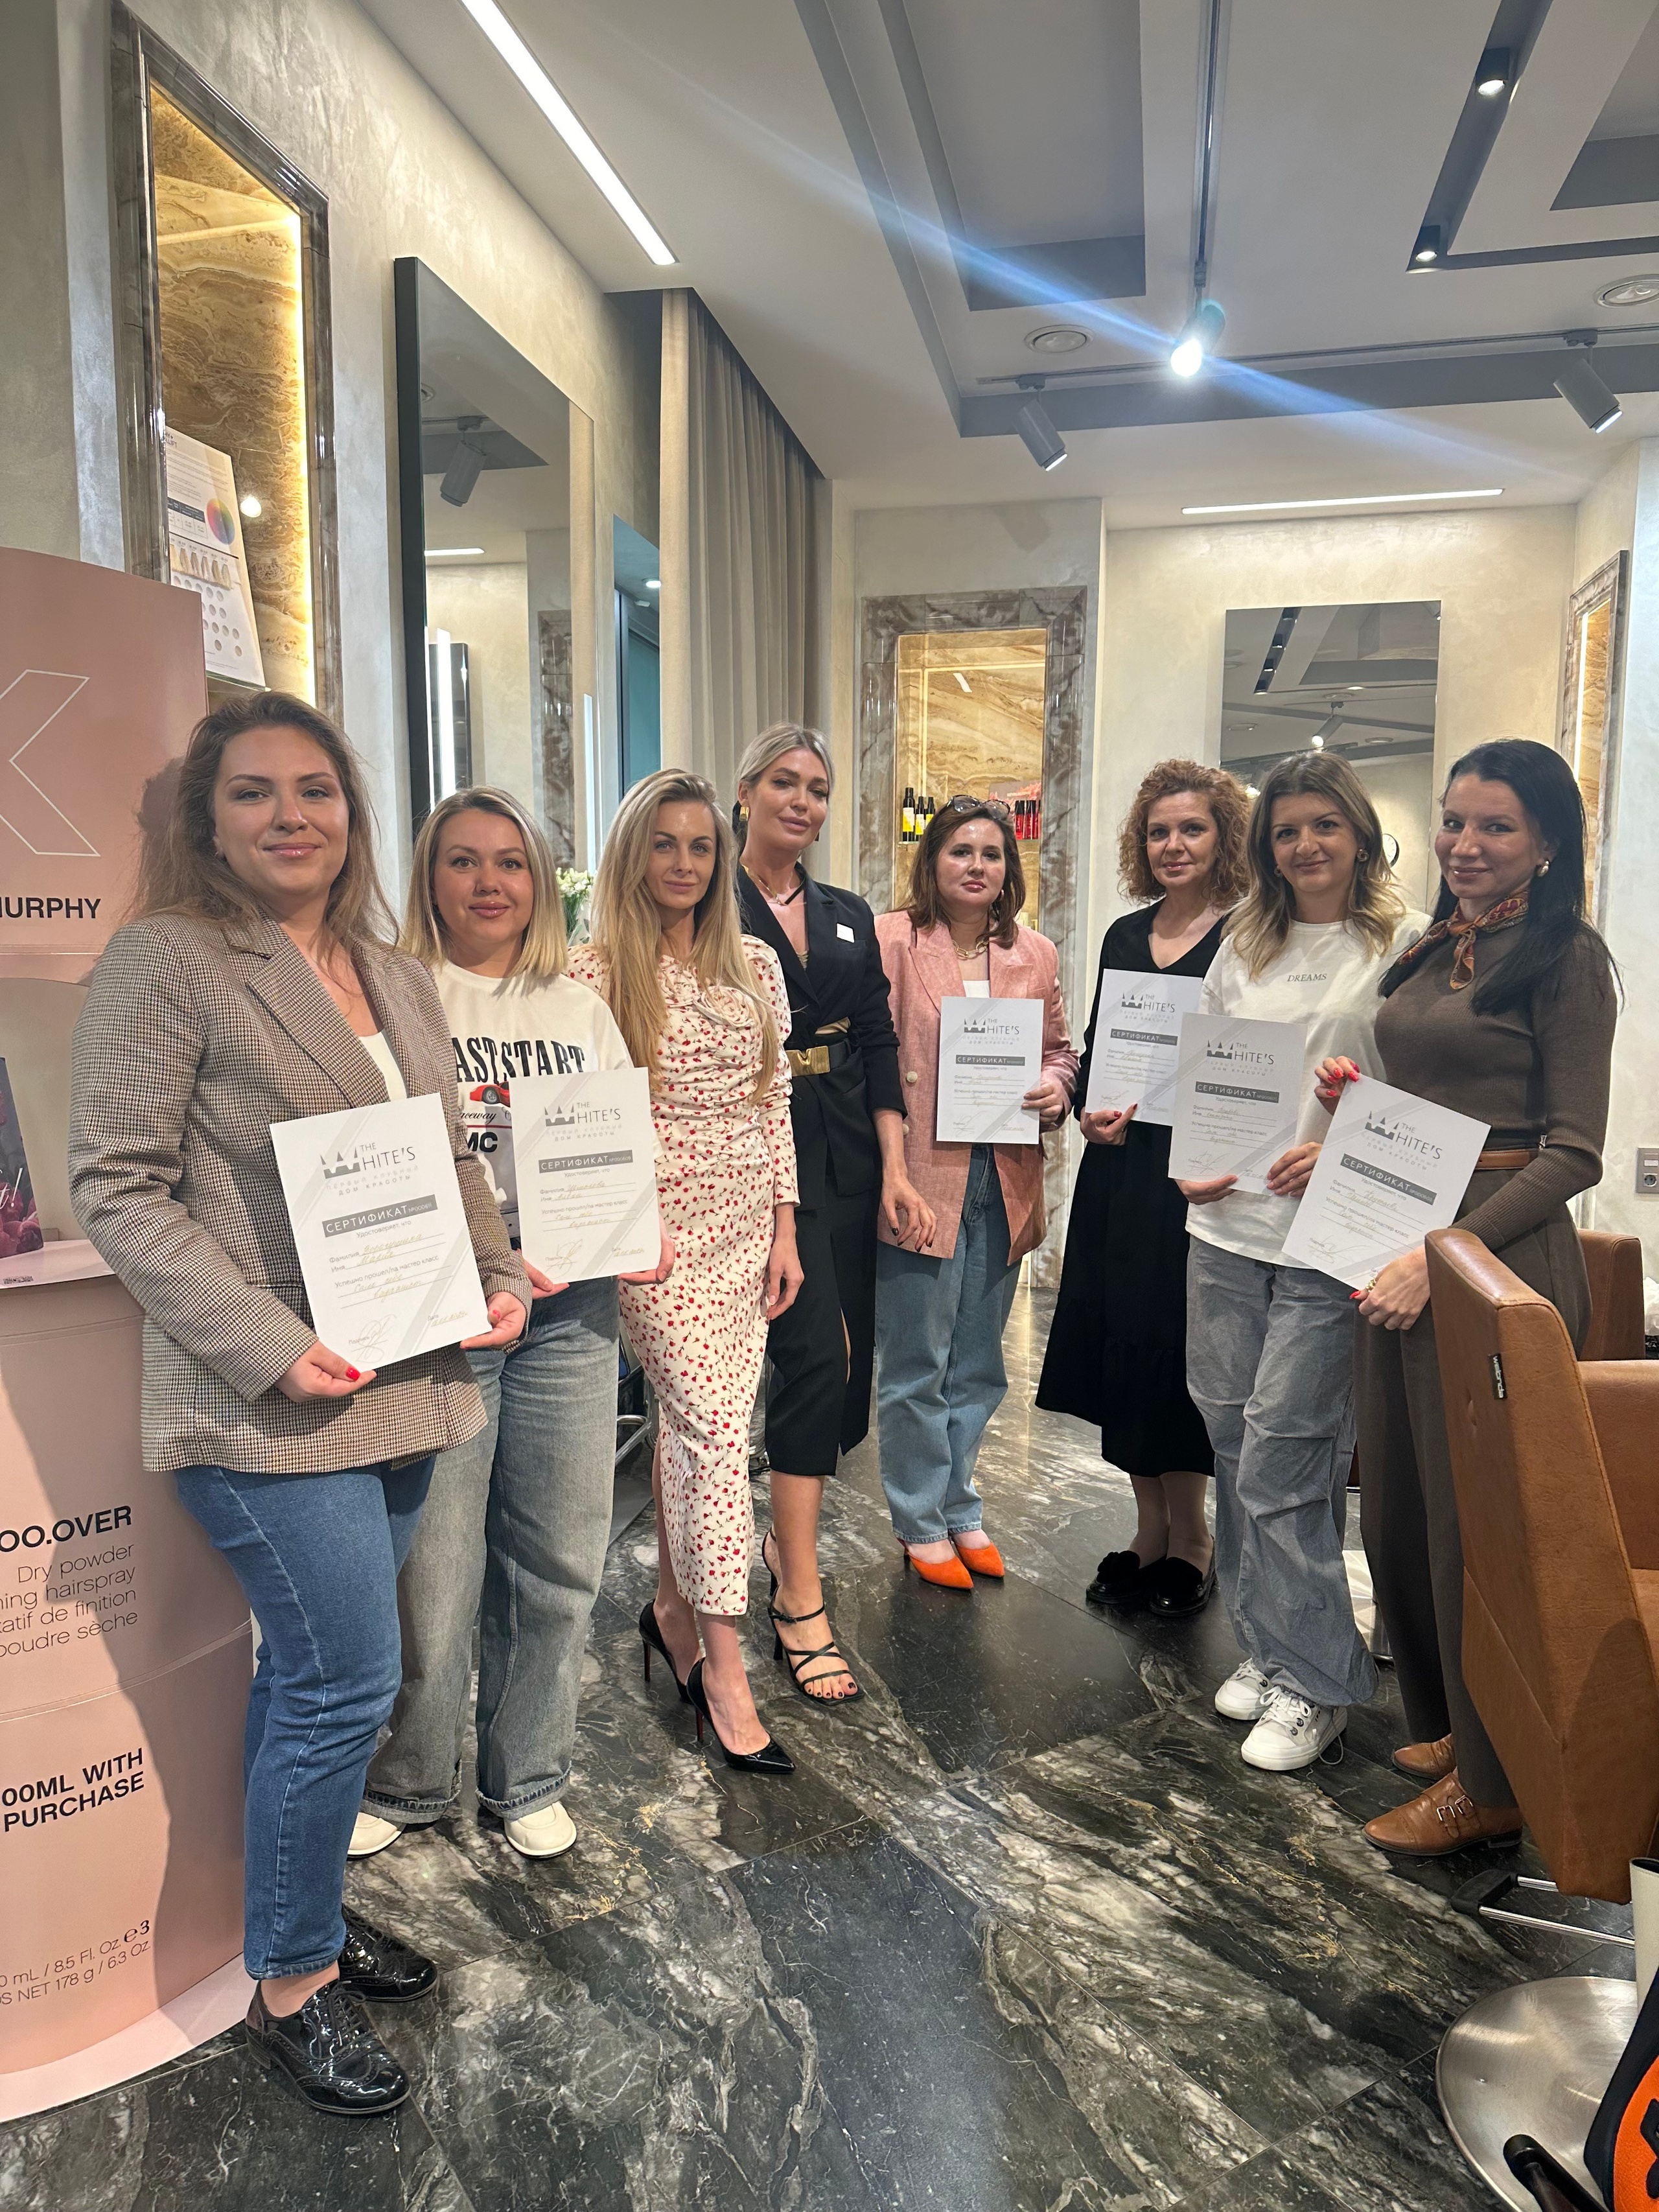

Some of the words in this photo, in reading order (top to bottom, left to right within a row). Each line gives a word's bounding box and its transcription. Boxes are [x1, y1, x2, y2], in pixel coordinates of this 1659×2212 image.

[0, 897, 101, 918] URPHY
[1287, 973, 1327, 983] DREAMS
[1112, 1030, 1159, 1042] СЕРТИФИКАТ
[1197, 1084, 1257, 1097] СЕРТИФИКАТ
[1402, 1123, 1416, 1133] THE
[360, 1142, 377, 1152] THE
[541, 1156, 609, 1170] СЕРТИФИКАТ
[1343, 1158, 1411, 1191] СЕРТИФИКАТ
[339, 1187, 358, 1196] ДОМ
[366, 1175, 411, 1189] КРАСОТЫ
[326, 1205, 408, 1233] СЕРТИФИКАТ
[329, 1252, 359, 1263] Фамилия
[399, 1260, 421, 1270] мастер
[422, 1255, 439, 1263] класс
[18, 1565, 52, 1583] Dry
[60, 1544, 133, 1579] powder
[46, 1566, 135, 1601] hairspray
[0, 1612, 33, 1633] atif
[41, 1607, 68, 1625] de
[75, 1590, 136, 1617] finition
[77, 1612, 137, 1639] sèche
[82, 1747, 143, 1785] WITH
[4, 1771, 145, 1832] PURCHASE
[0, 1992, 12, 2005] S
[18, 1981, 51, 2002] NET
[56, 1972, 78, 1990] 178
[84, 1968, 93, 1983] g
[99, 1961, 103, 1974] /
[108, 1951, 126, 1968] 6.3
[14, 1969, 40, 1985] mL
[44, 1963, 49, 1977] /
[54, 1955, 75, 1973] 8.5
